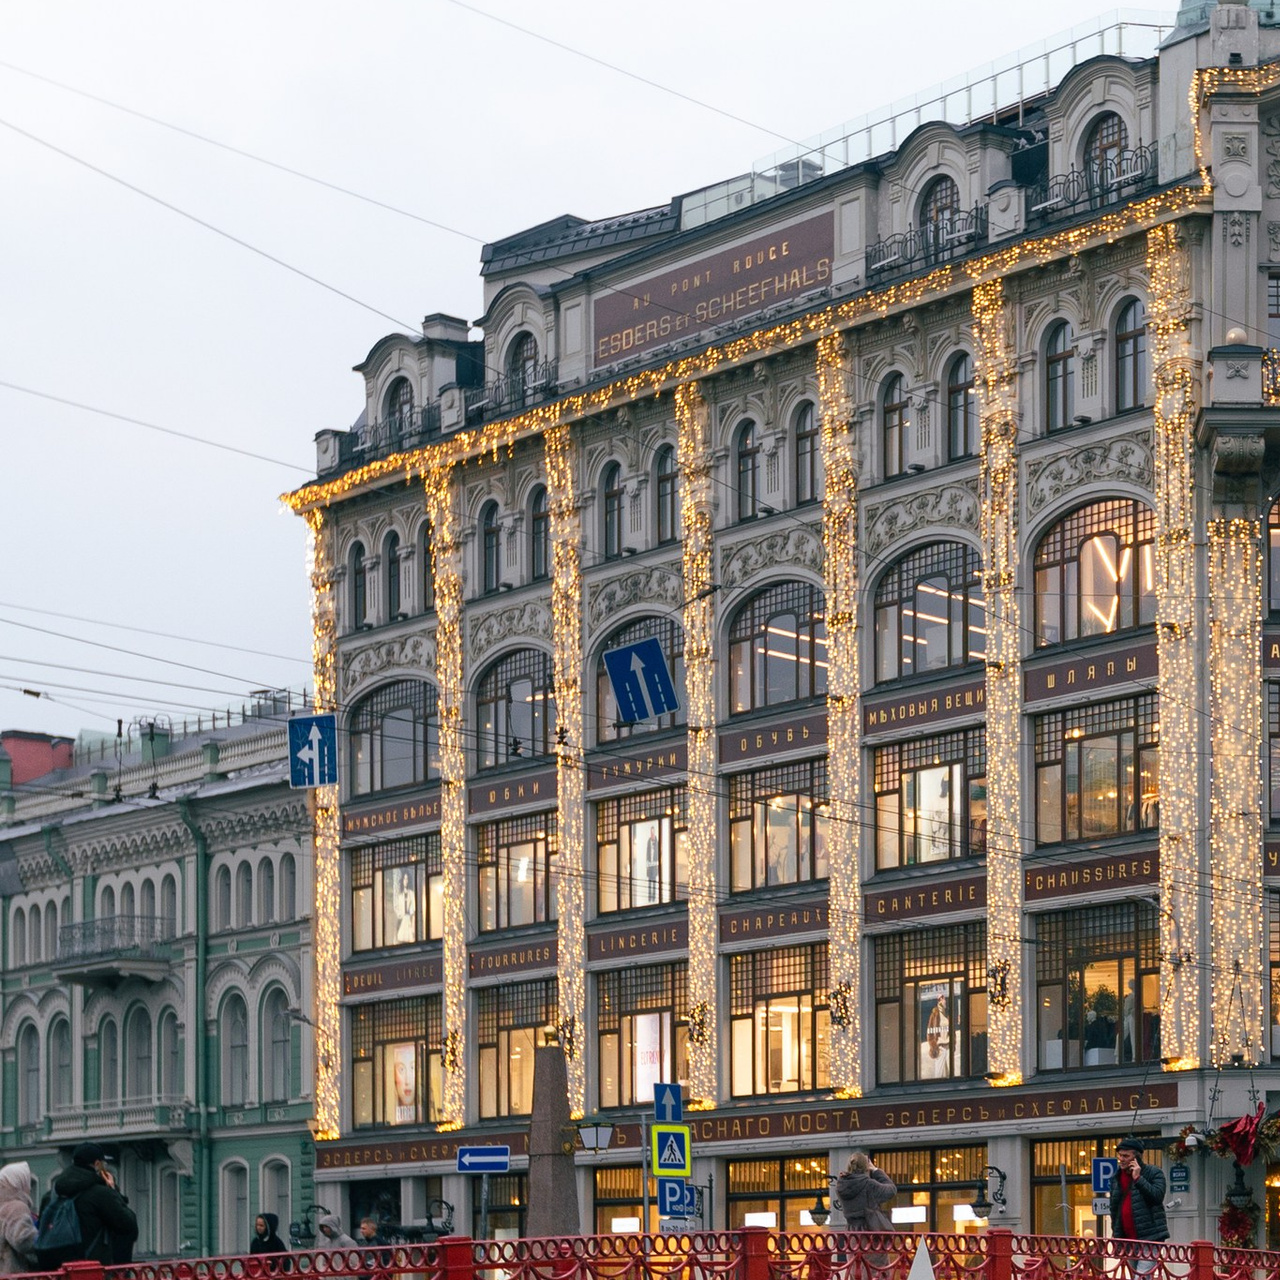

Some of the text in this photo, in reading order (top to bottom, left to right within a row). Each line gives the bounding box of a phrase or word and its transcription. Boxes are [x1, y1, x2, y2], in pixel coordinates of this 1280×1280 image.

[633, 242, 789, 310] AU PONT ROUGE
[599, 315, 671, 358] ESDERS
[695, 258, 830, 324] SCHEEFHALS
[1046, 657, 1138, 689] ШЛЯПЫ
[946, 688, 984, 709] ВЕЩИ
[741, 726, 809, 751] ОБУВЬ
[602, 753, 676, 779] ТУЖУРКИ
[489, 784, 539, 803] ЮБКИ
[347, 809, 398, 831] МУЖСКОЕ
[1268, 851, 1278, 866] У
[1036, 859, 1152, 890] CHAUSSURES
[731, 909, 821, 933] CHAPEAUX
[600, 929, 677, 952] LINGERIE
[480, 947, 550, 969] FOURRURES
[353, 973, 383, 988] DEUIL
[692, 1117, 770, 1140] АСНАГО
[783, 1110, 860, 1133] МОСТА
[885, 1106, 989, 1127] ЭСДЕРСЪ
[1014, 1094, 1160, 1117] СХЕФАЛЬСЪ
[323, 1148, 393, 1166] ЭСДЕРСЪ
[665, 1182, 681, 1211] P
